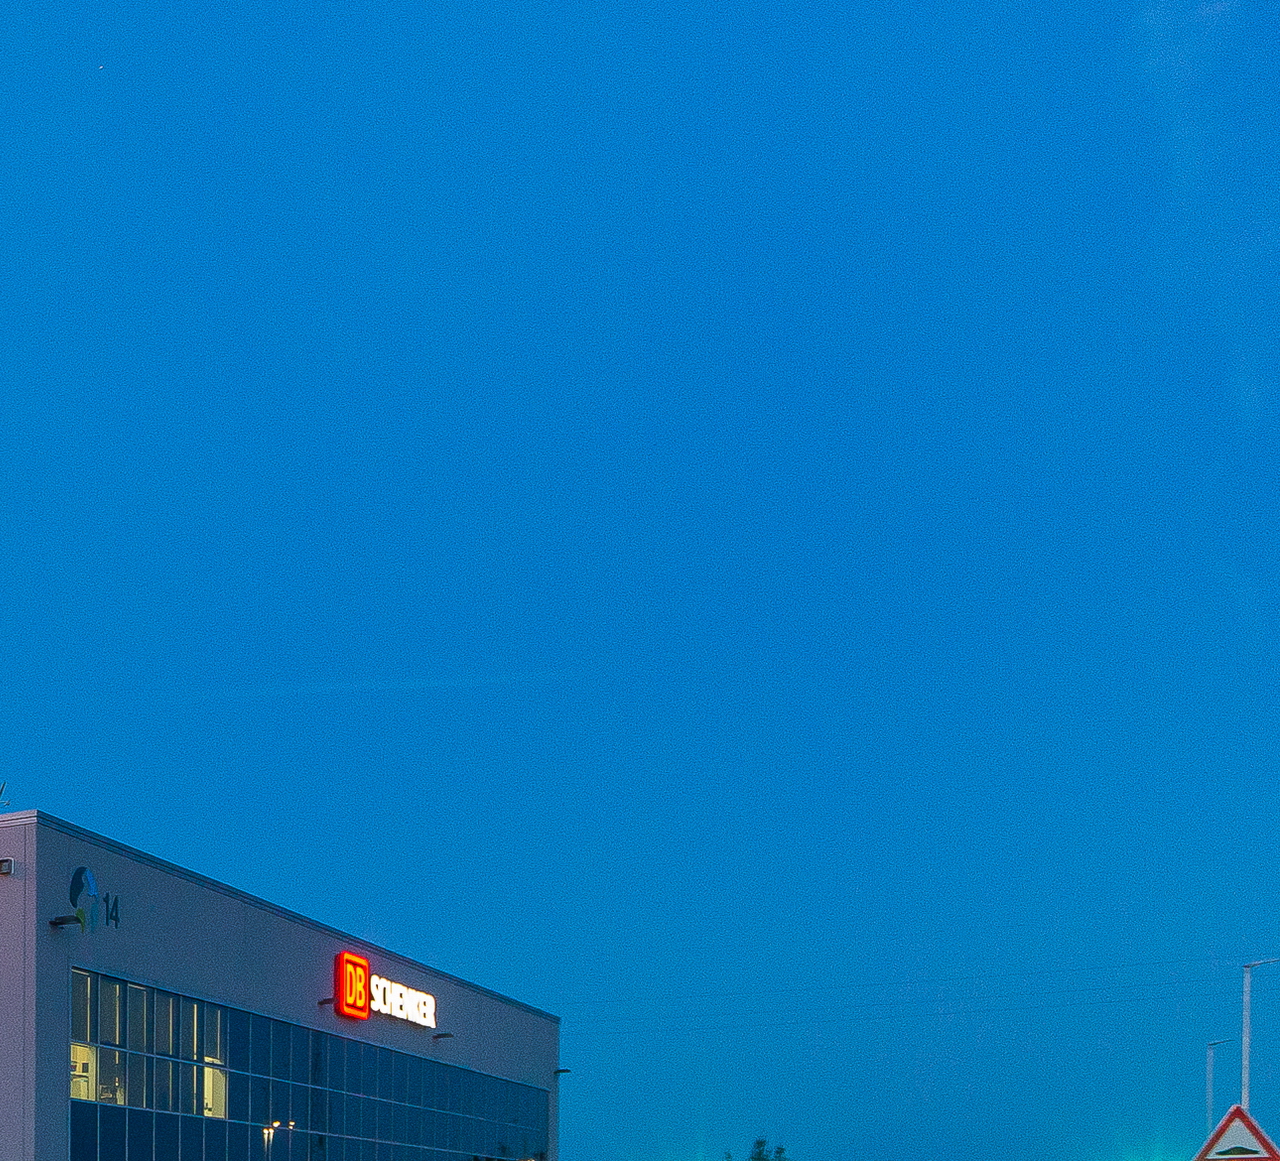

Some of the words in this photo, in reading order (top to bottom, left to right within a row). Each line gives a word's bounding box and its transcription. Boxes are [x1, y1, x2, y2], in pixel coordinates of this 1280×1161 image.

[102, 891, 121, 930] 14
[345, 962, 366, 1009] DB
[370, 973, 437, 1029] SCHENKER
